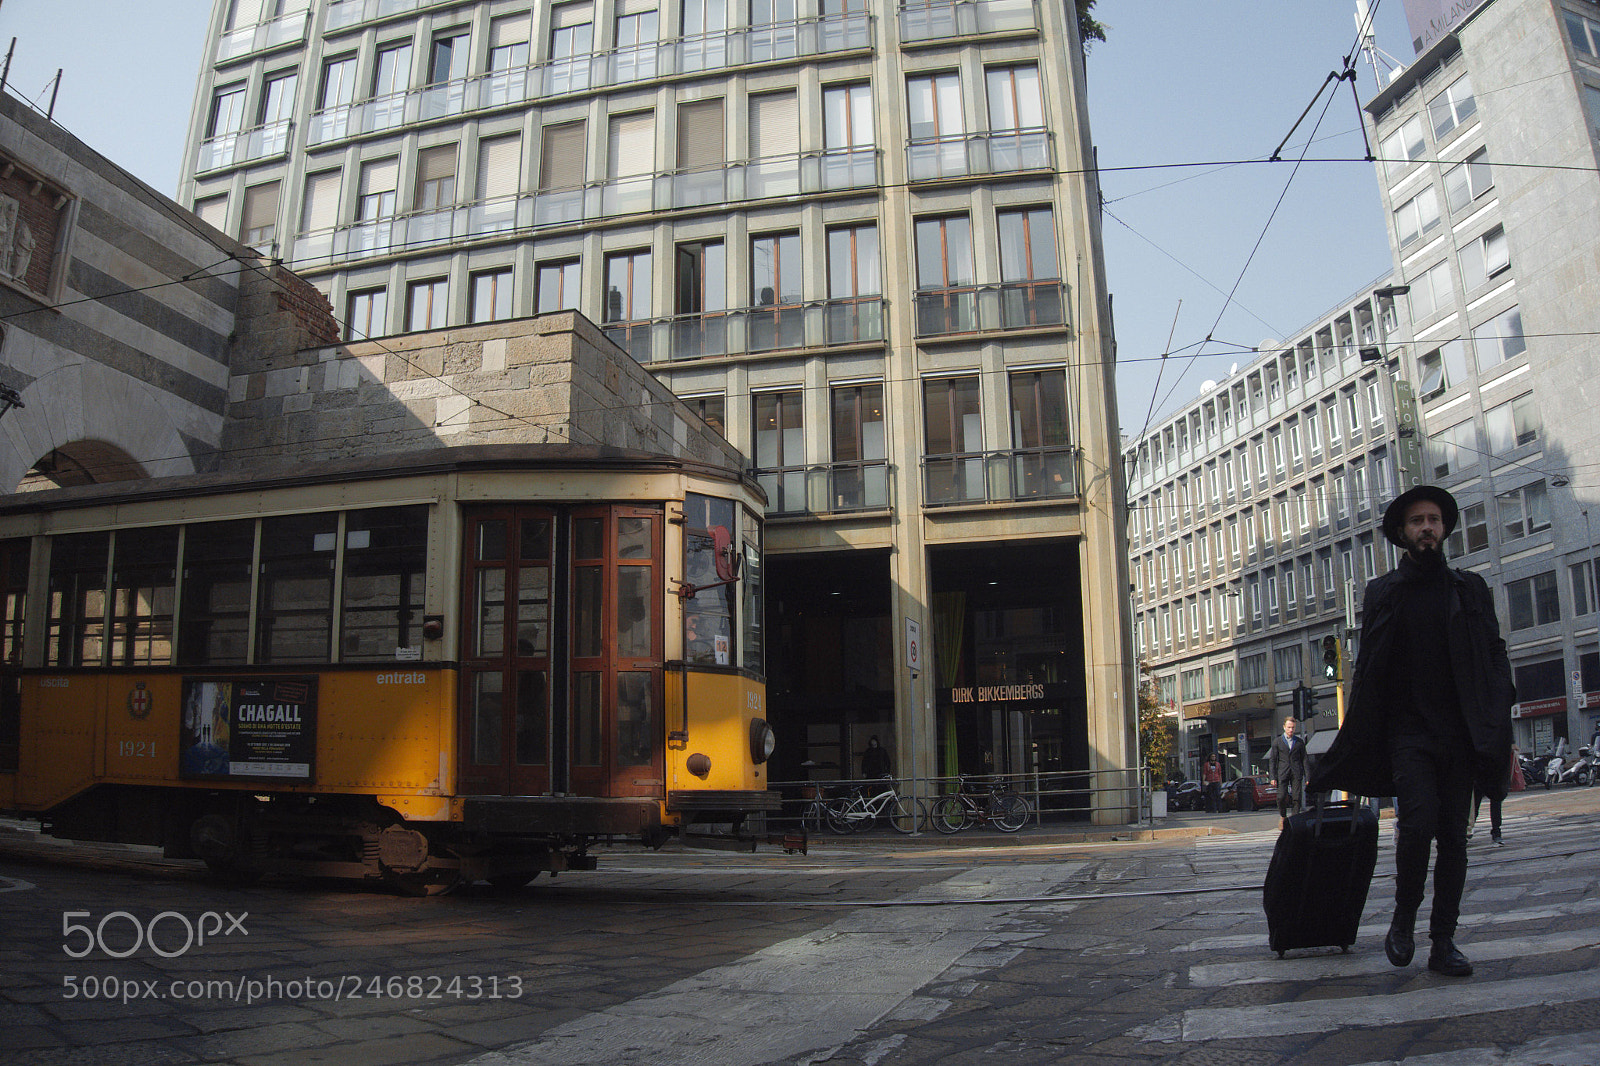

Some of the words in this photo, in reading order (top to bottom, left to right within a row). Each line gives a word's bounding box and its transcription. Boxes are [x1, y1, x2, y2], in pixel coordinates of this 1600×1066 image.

[40, 677, 69, 688] uscita
[377, 671, 426, 684] entrata
[747, 691, 762, 712] 1924
[952, 687, 974, 703] DIRK
[978, 684, 1044, 703] BIKKEMBERGS
[238, 704, 302, 722] CHAGALL
[119, 740, 157, 758] 1924
